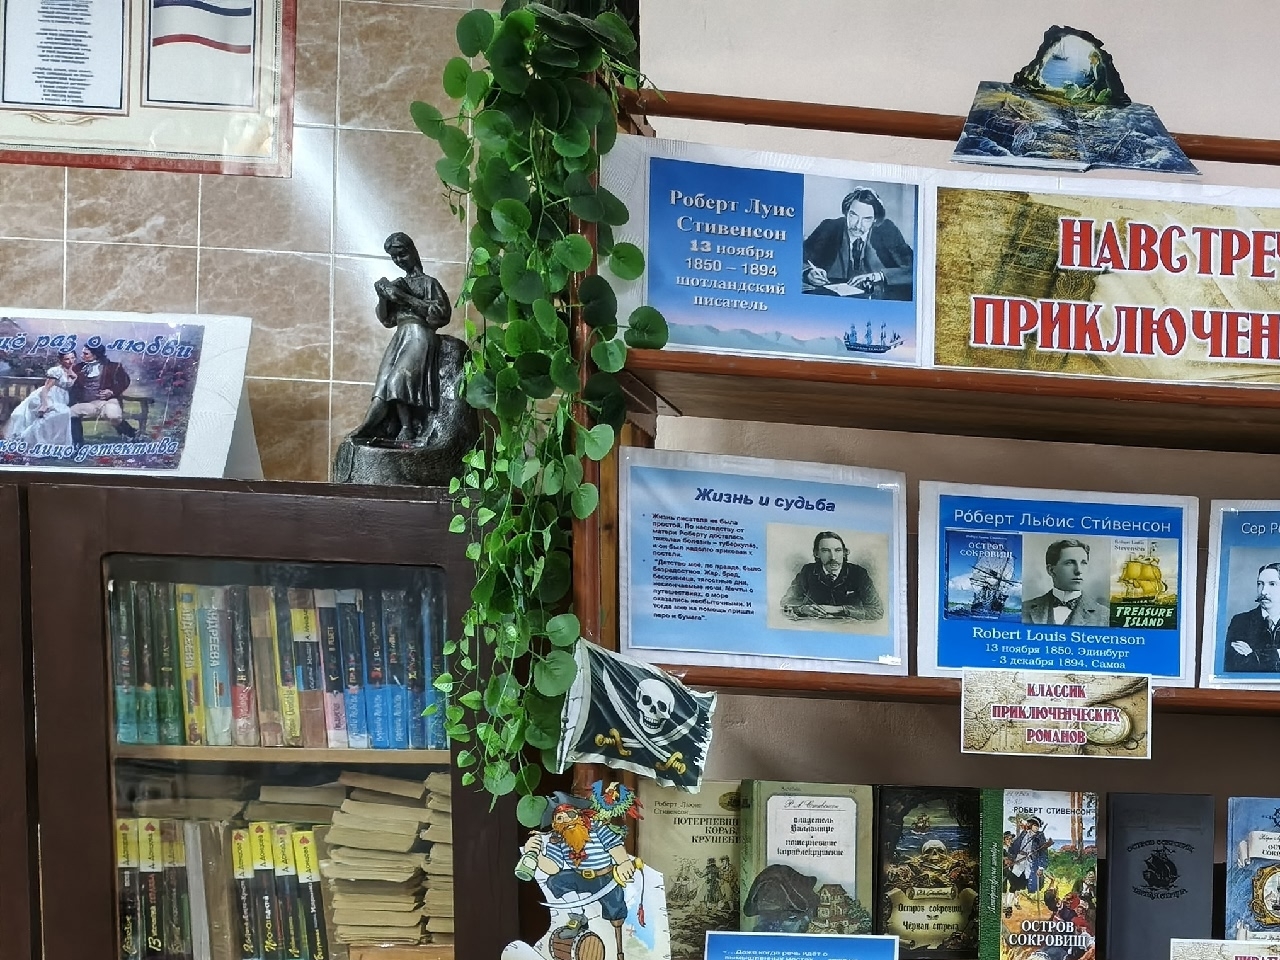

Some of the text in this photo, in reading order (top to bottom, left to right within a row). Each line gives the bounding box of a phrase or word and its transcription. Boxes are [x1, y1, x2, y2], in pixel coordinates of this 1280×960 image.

[669, 189, 796, 219] Роберт Луис
[676, 215, 787, 242] Стивенсон
[689, 239, 774, 261] 13 ноября
[685, 258, 778, 277] 1850 1894
[676, 274, 786, 296] шотландский
[693, 294, 768, 312] писатель
[30, 333, 78, 355] раз
[88, 336, 102, 349] о
[107, 336, 193, 359] любви
[30, 443, 73, 458] лицо
[74, 438, 179, 461] детектива
[695, 488, 836, 512] Жизнь и судьба
[1241, 523, 1266, 535] Сер
[1116, 607, 1174, 618] TREASURE
[1123, 616, 1164, 627] ISLAND
[973, 627, 1145, 645] Robert Louis Stevenson
[985, 644, 1129, 658] 13 ноября Эдинбург
[1010, 657, 1125, 669] декабря Самоа
[1027, 683, 1086, 698] КЛАССИК
[992, 705, 1120, 723] ПРИКЛЮЧЕНЧЕСКИХ
[1027, 729, 1086, 744] РОМАНОВ
[1014, 806, 1091, 816] РОБЕРТ СТИВЕНСОН
[1021, 920, 1074, 932] ОСТРОВ
[1009, 934, 1087, 947] СОКРОВИЩ
